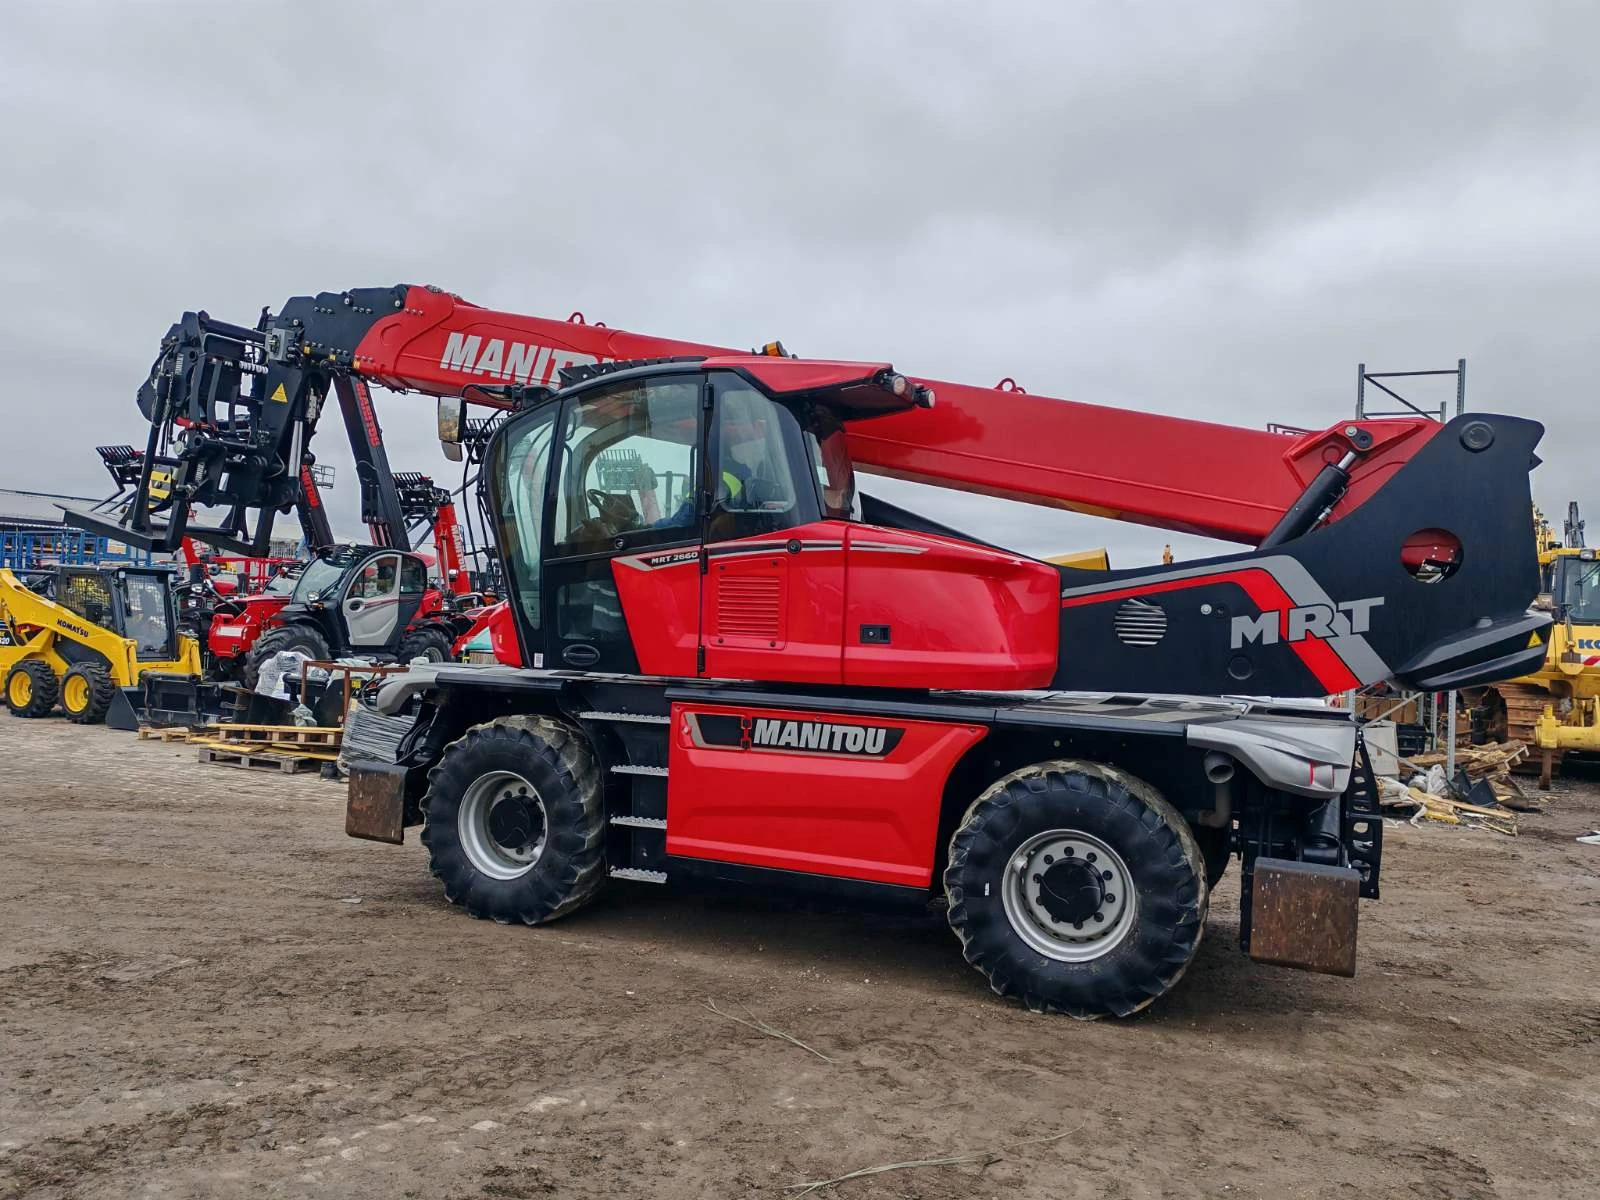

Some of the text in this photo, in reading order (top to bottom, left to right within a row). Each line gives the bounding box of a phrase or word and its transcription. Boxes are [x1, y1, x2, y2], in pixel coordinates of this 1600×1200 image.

[440, 332, 629, 388] MANIT
[651, 551, 698, 565] MRT 2660
[57, 618, 89, 638] KOMATSU
[1231, 596, 1385, 649] MRT
[753, 718, 887, 754] MANITOU
